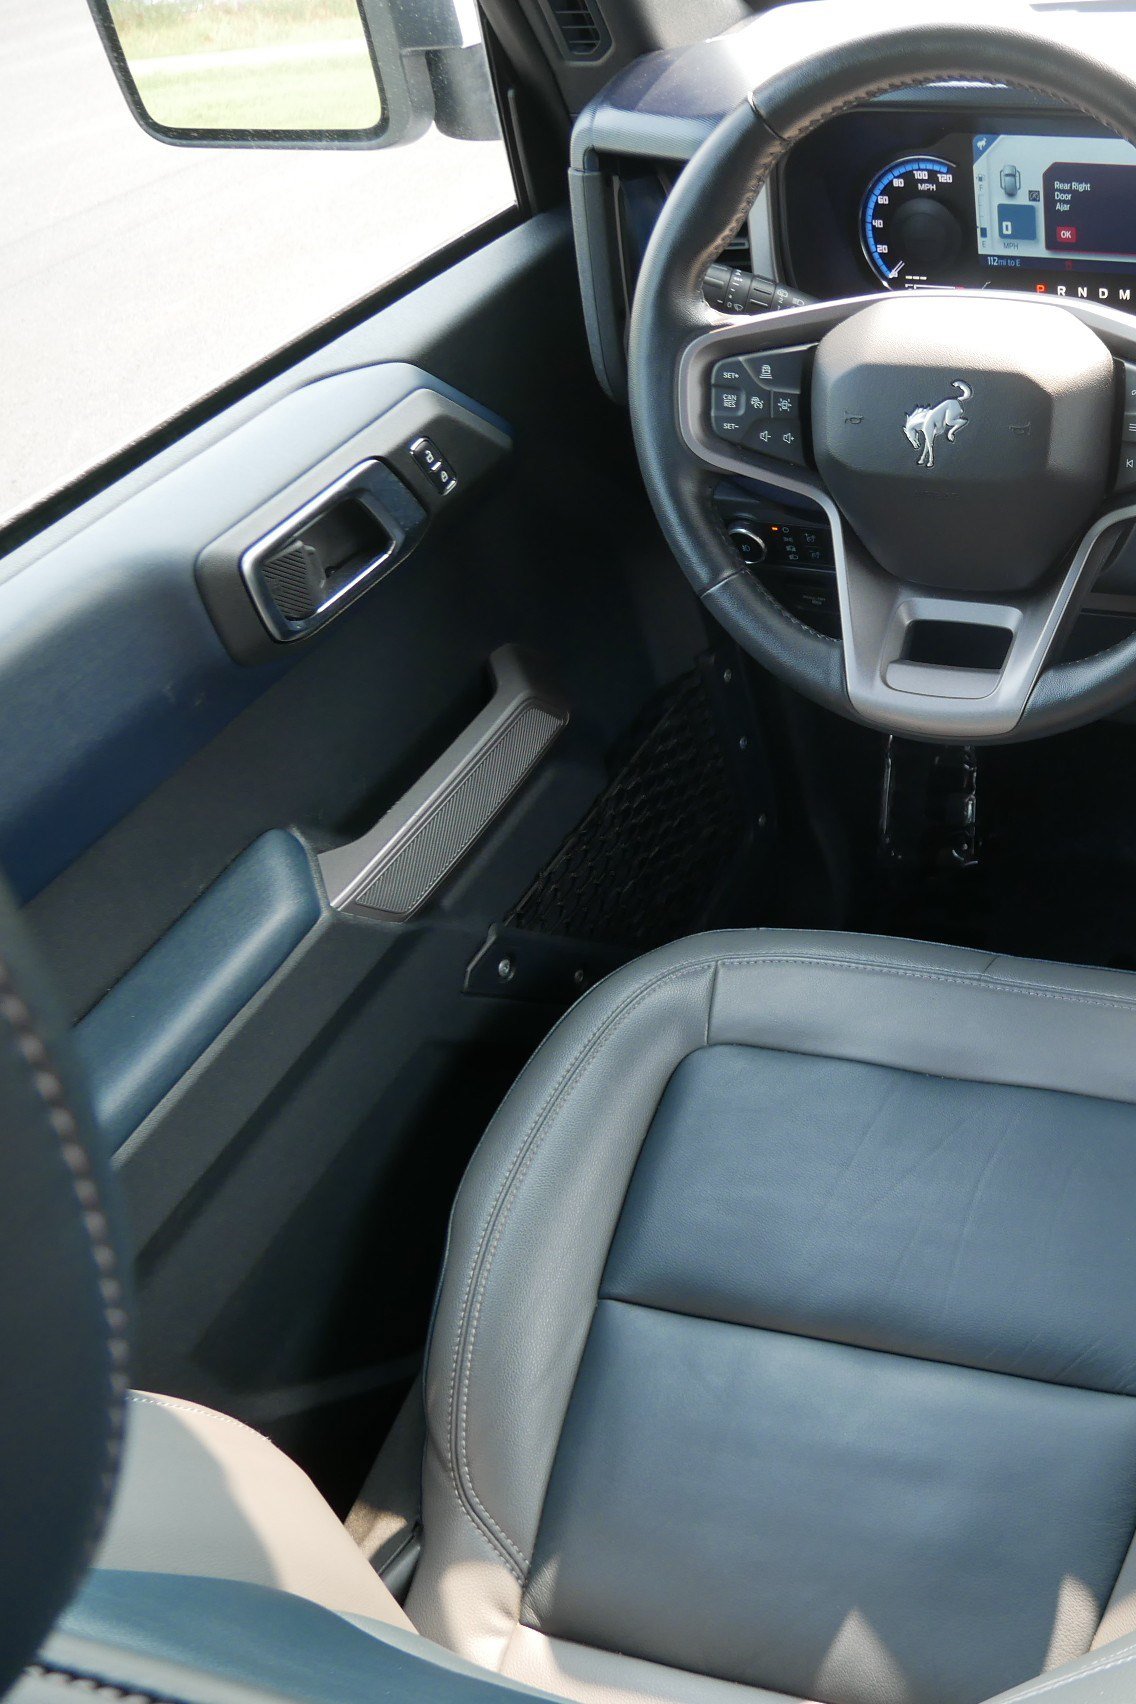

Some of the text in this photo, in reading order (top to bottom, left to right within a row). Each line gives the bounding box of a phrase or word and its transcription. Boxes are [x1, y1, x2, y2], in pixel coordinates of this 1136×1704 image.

[913, 171, 929, 180] 100
[937, 174, 953, 183] 120
[893, 178, 904, 187] 80
[1054, 181, 1091, 192] Rear Right
[918, 183, 937, 191] MPH
[877, 196, 889, 204] 60
[1054, 192, 1072, 200] Door
[1056, 203, 1070, 211] Ajar
[872, 220, 883, 228] 40
[1002, 221, 1012, 235] 0
[1060, 231, 1072, 239] OK
[877, 245, 888, 253] 20
[1003, 242, 1019, 250] MPH
[1008, 258, 1015, 266] to
[1036, 284, 1131, 300] P R N D M
